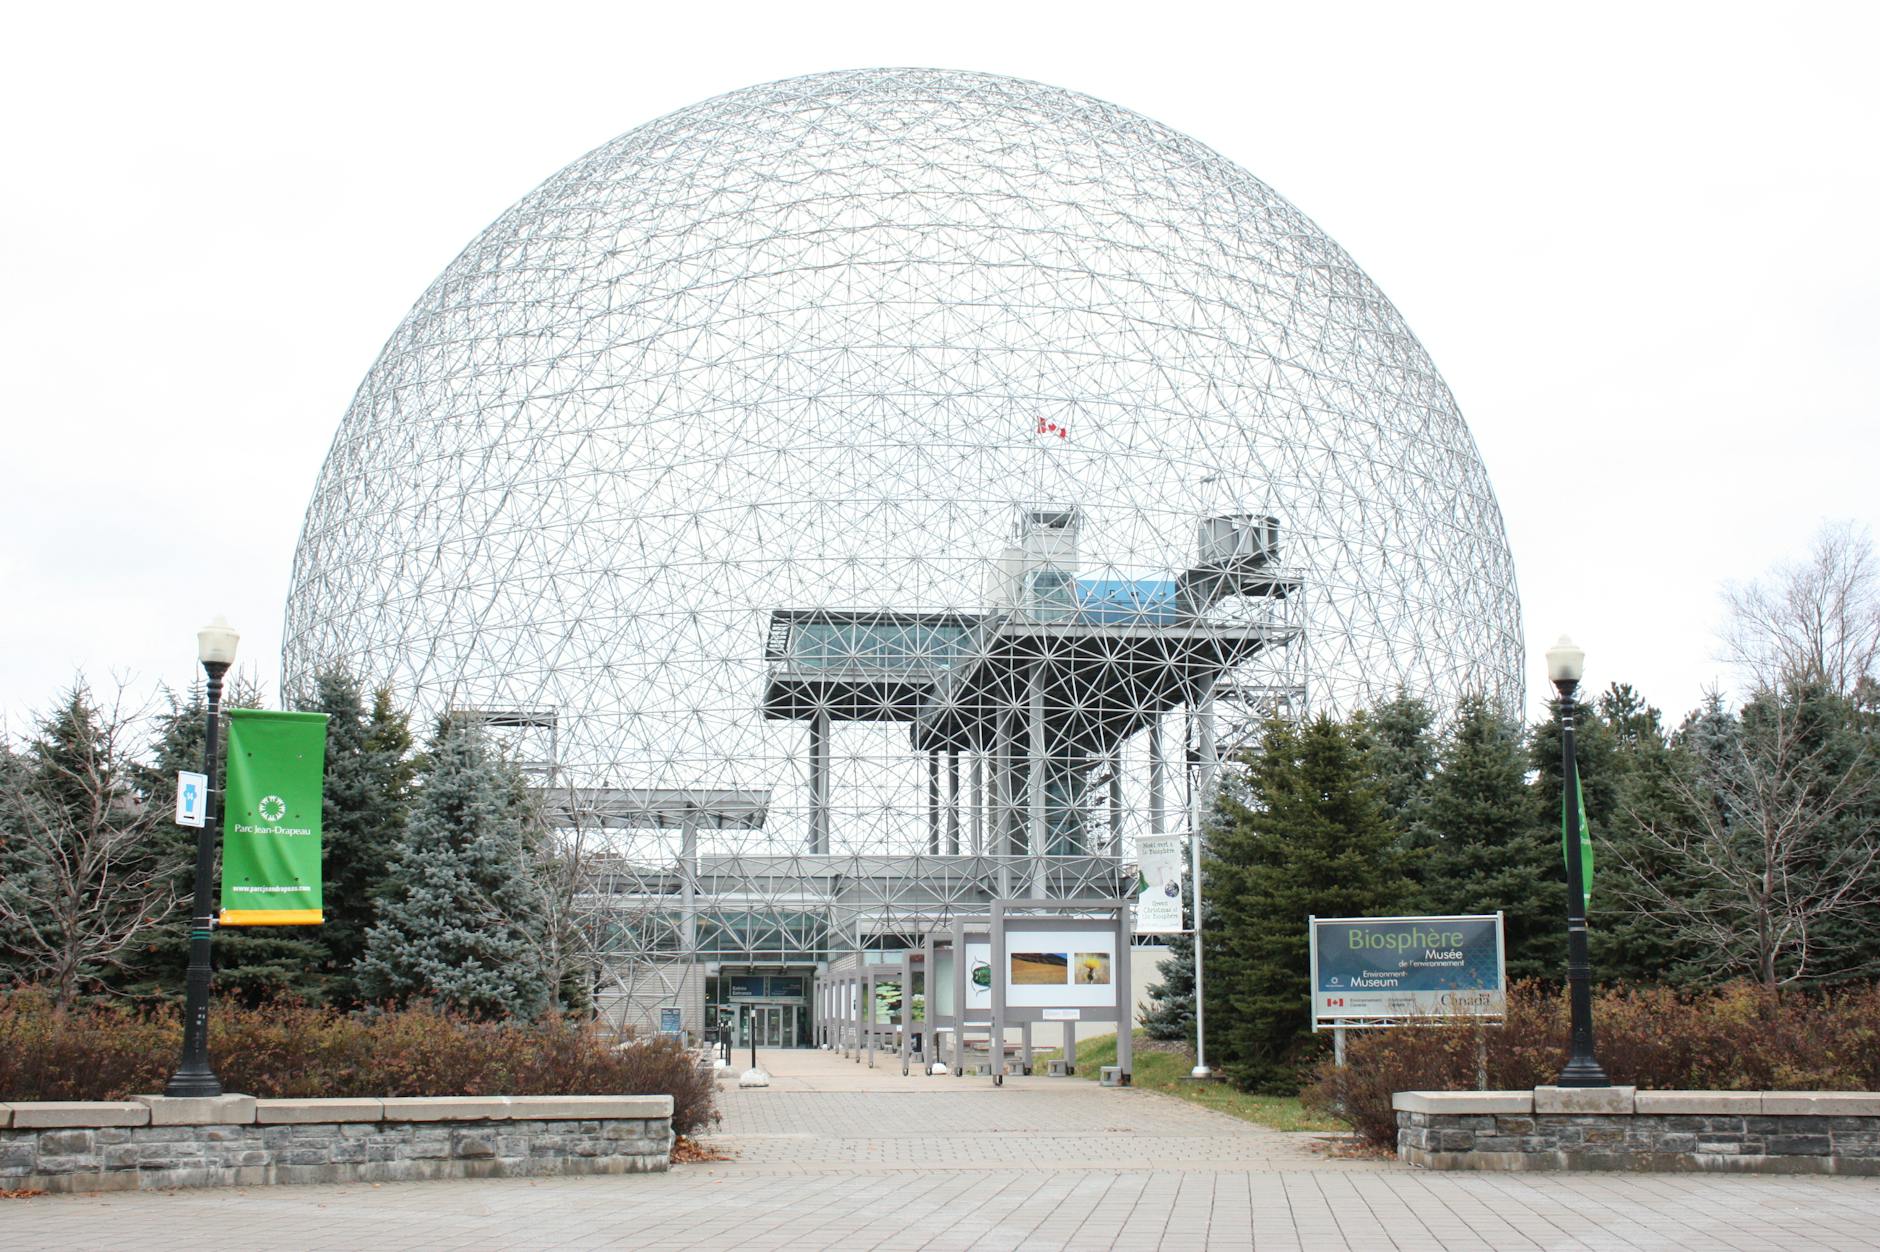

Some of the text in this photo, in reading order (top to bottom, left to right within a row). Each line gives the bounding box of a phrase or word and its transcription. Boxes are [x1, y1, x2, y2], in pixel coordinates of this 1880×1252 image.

[234, 824, 311, 836] Parc Jean-Drapeau
[1349, 928, 1464, 953] Biosphère
[1425, 950, 1463, 960] Musée
[1350, 977, 1398, 988] Museum
